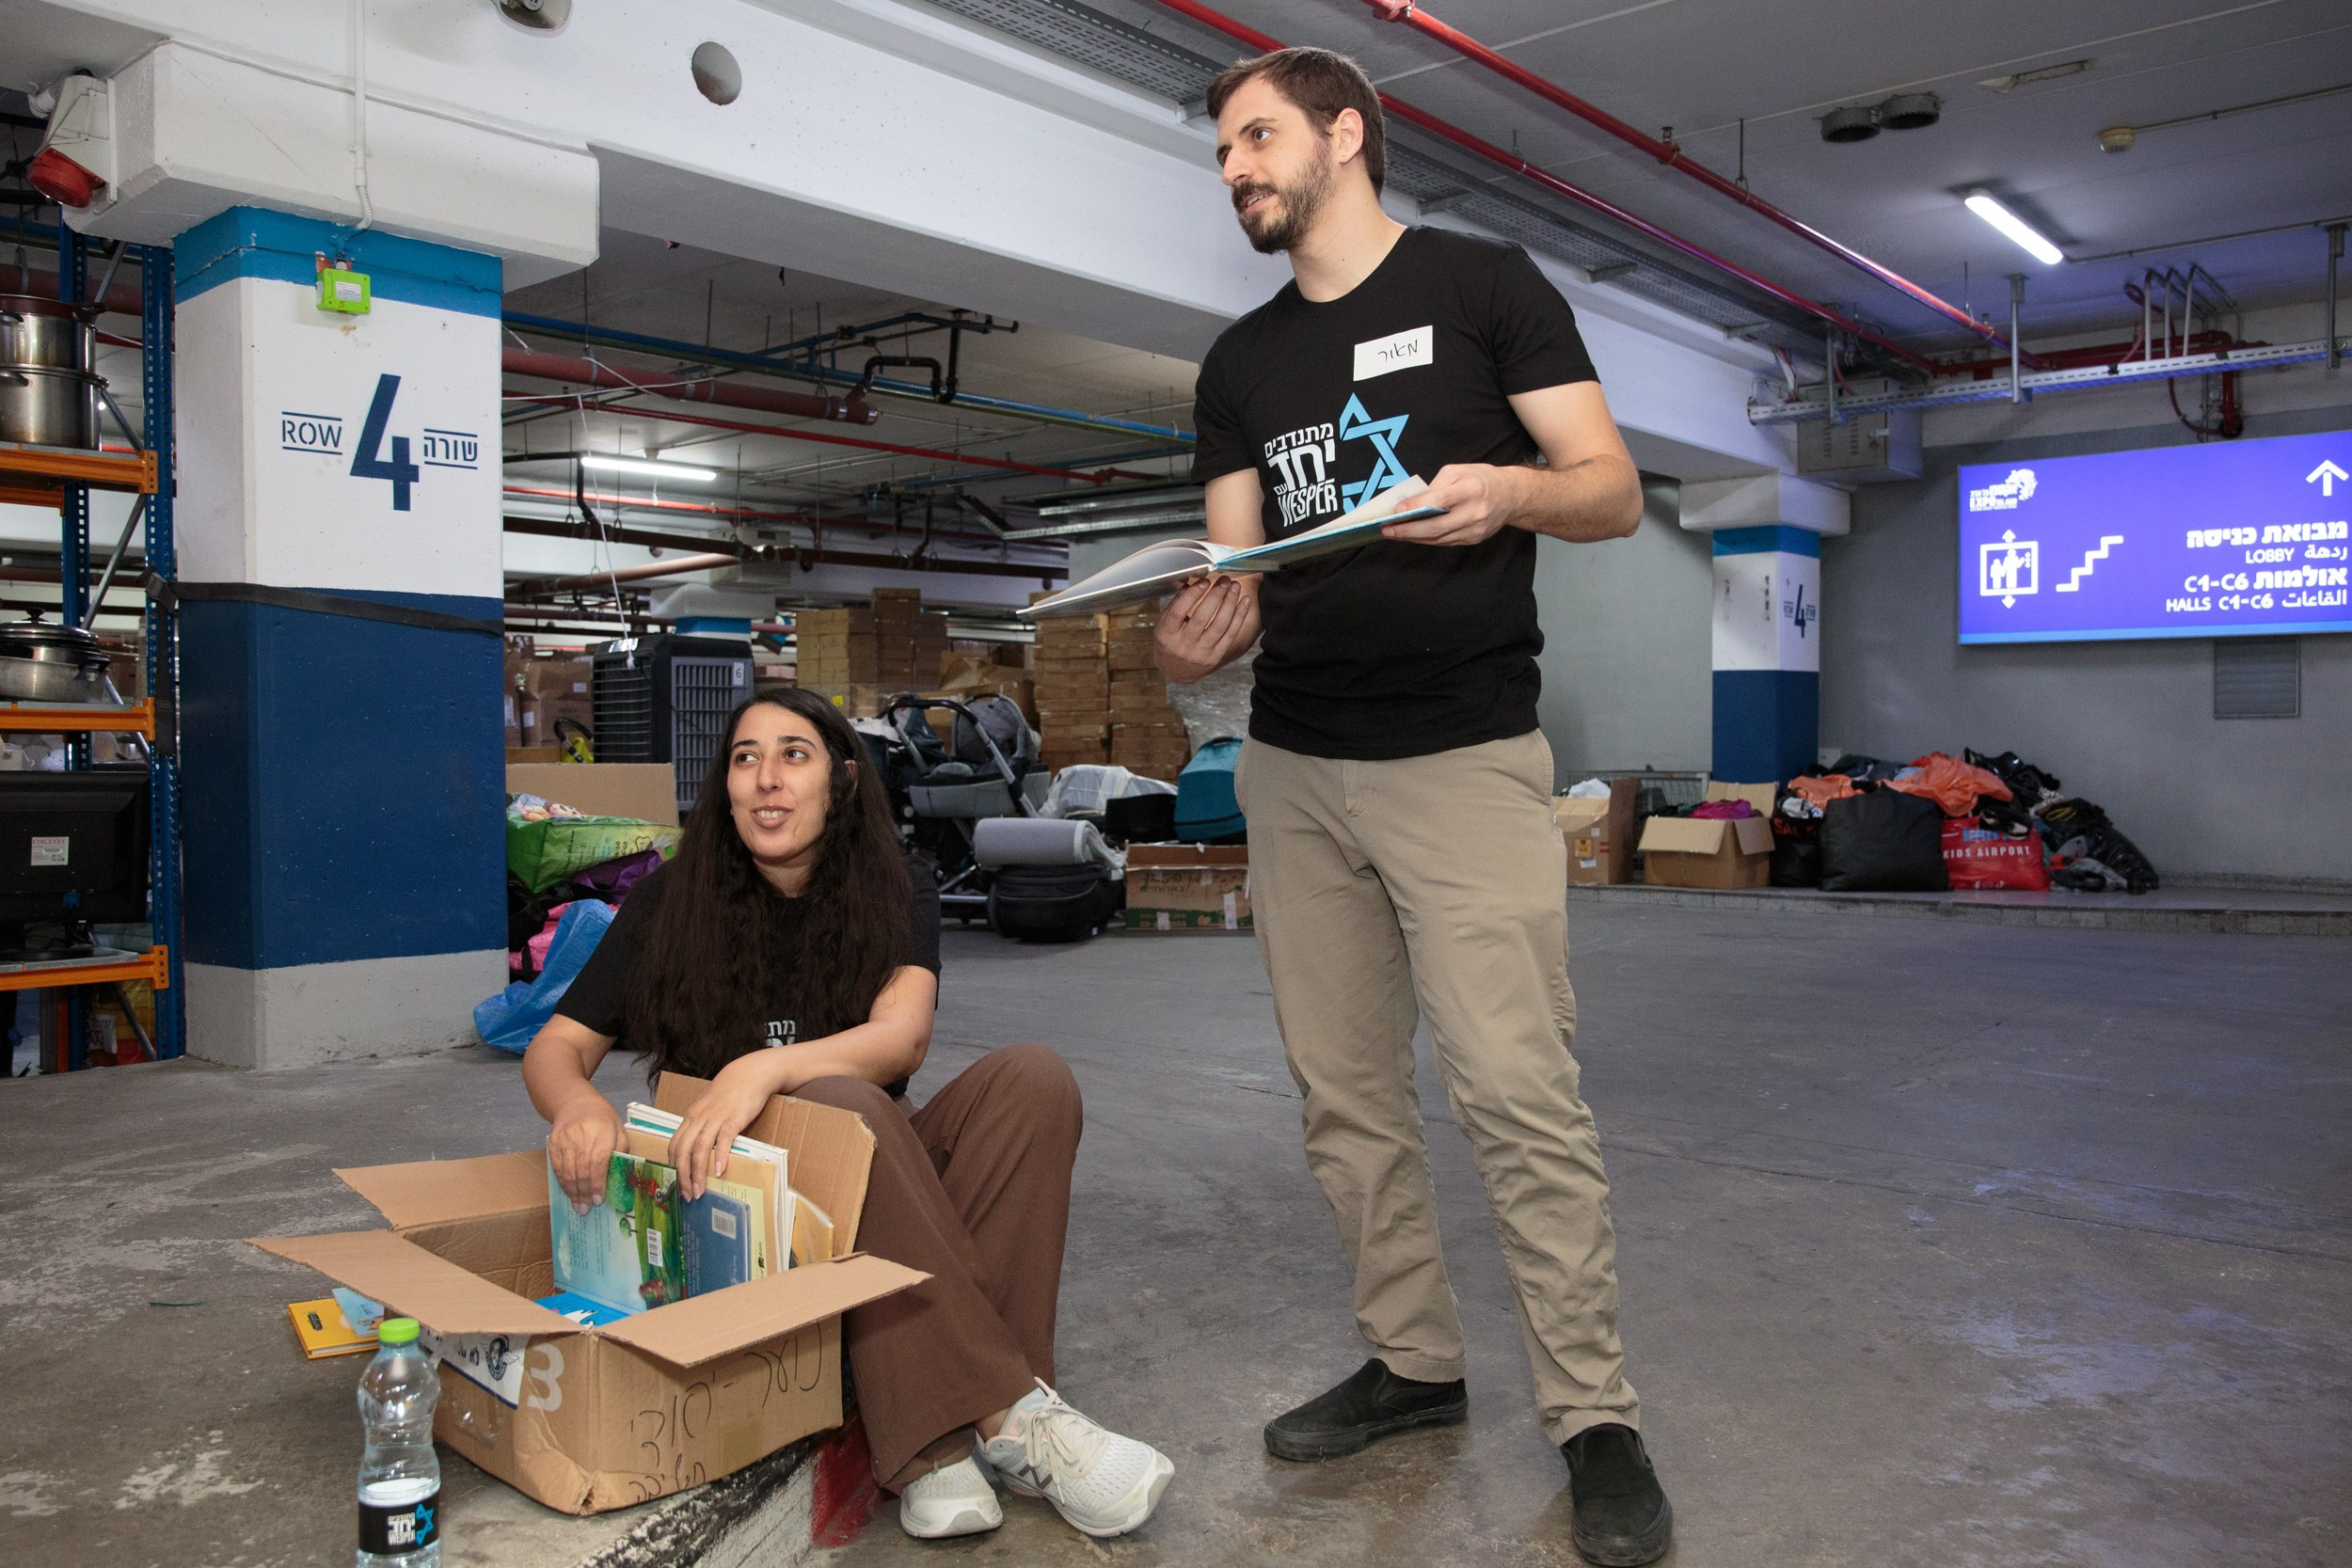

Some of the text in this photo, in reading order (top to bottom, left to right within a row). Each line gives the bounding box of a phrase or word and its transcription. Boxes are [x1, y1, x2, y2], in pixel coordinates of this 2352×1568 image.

[1377, 339, 1418, 362] מאור
[282, 373, 420, 512] ROW 4
[424, 436, 478, 463] שורה
[1264, 422, 1334, 459] מתנדבים
[1267, 438, 1336, 492] יחד
[1273, 483, 1288, 496] עם
[1278, 478, 1339, 527] WESPER
[2186, 521, 2348, 548] מבואת כניסה
[2245, 547, 2296, 564] LOBBY
[2304, 544, 2348, 561] ردهة
[2184, 564, 2348, 593] אולמות C1-C6
[2166, 593, 2275, 612] HALLS C1-C6
[2281, 589, 2347, 608] القاعات
[1794, 584, 1806, 639] 4
[736, 668, 742, 678] 6
[1943, 846, 2030, 859] KIDS AIRPORT
